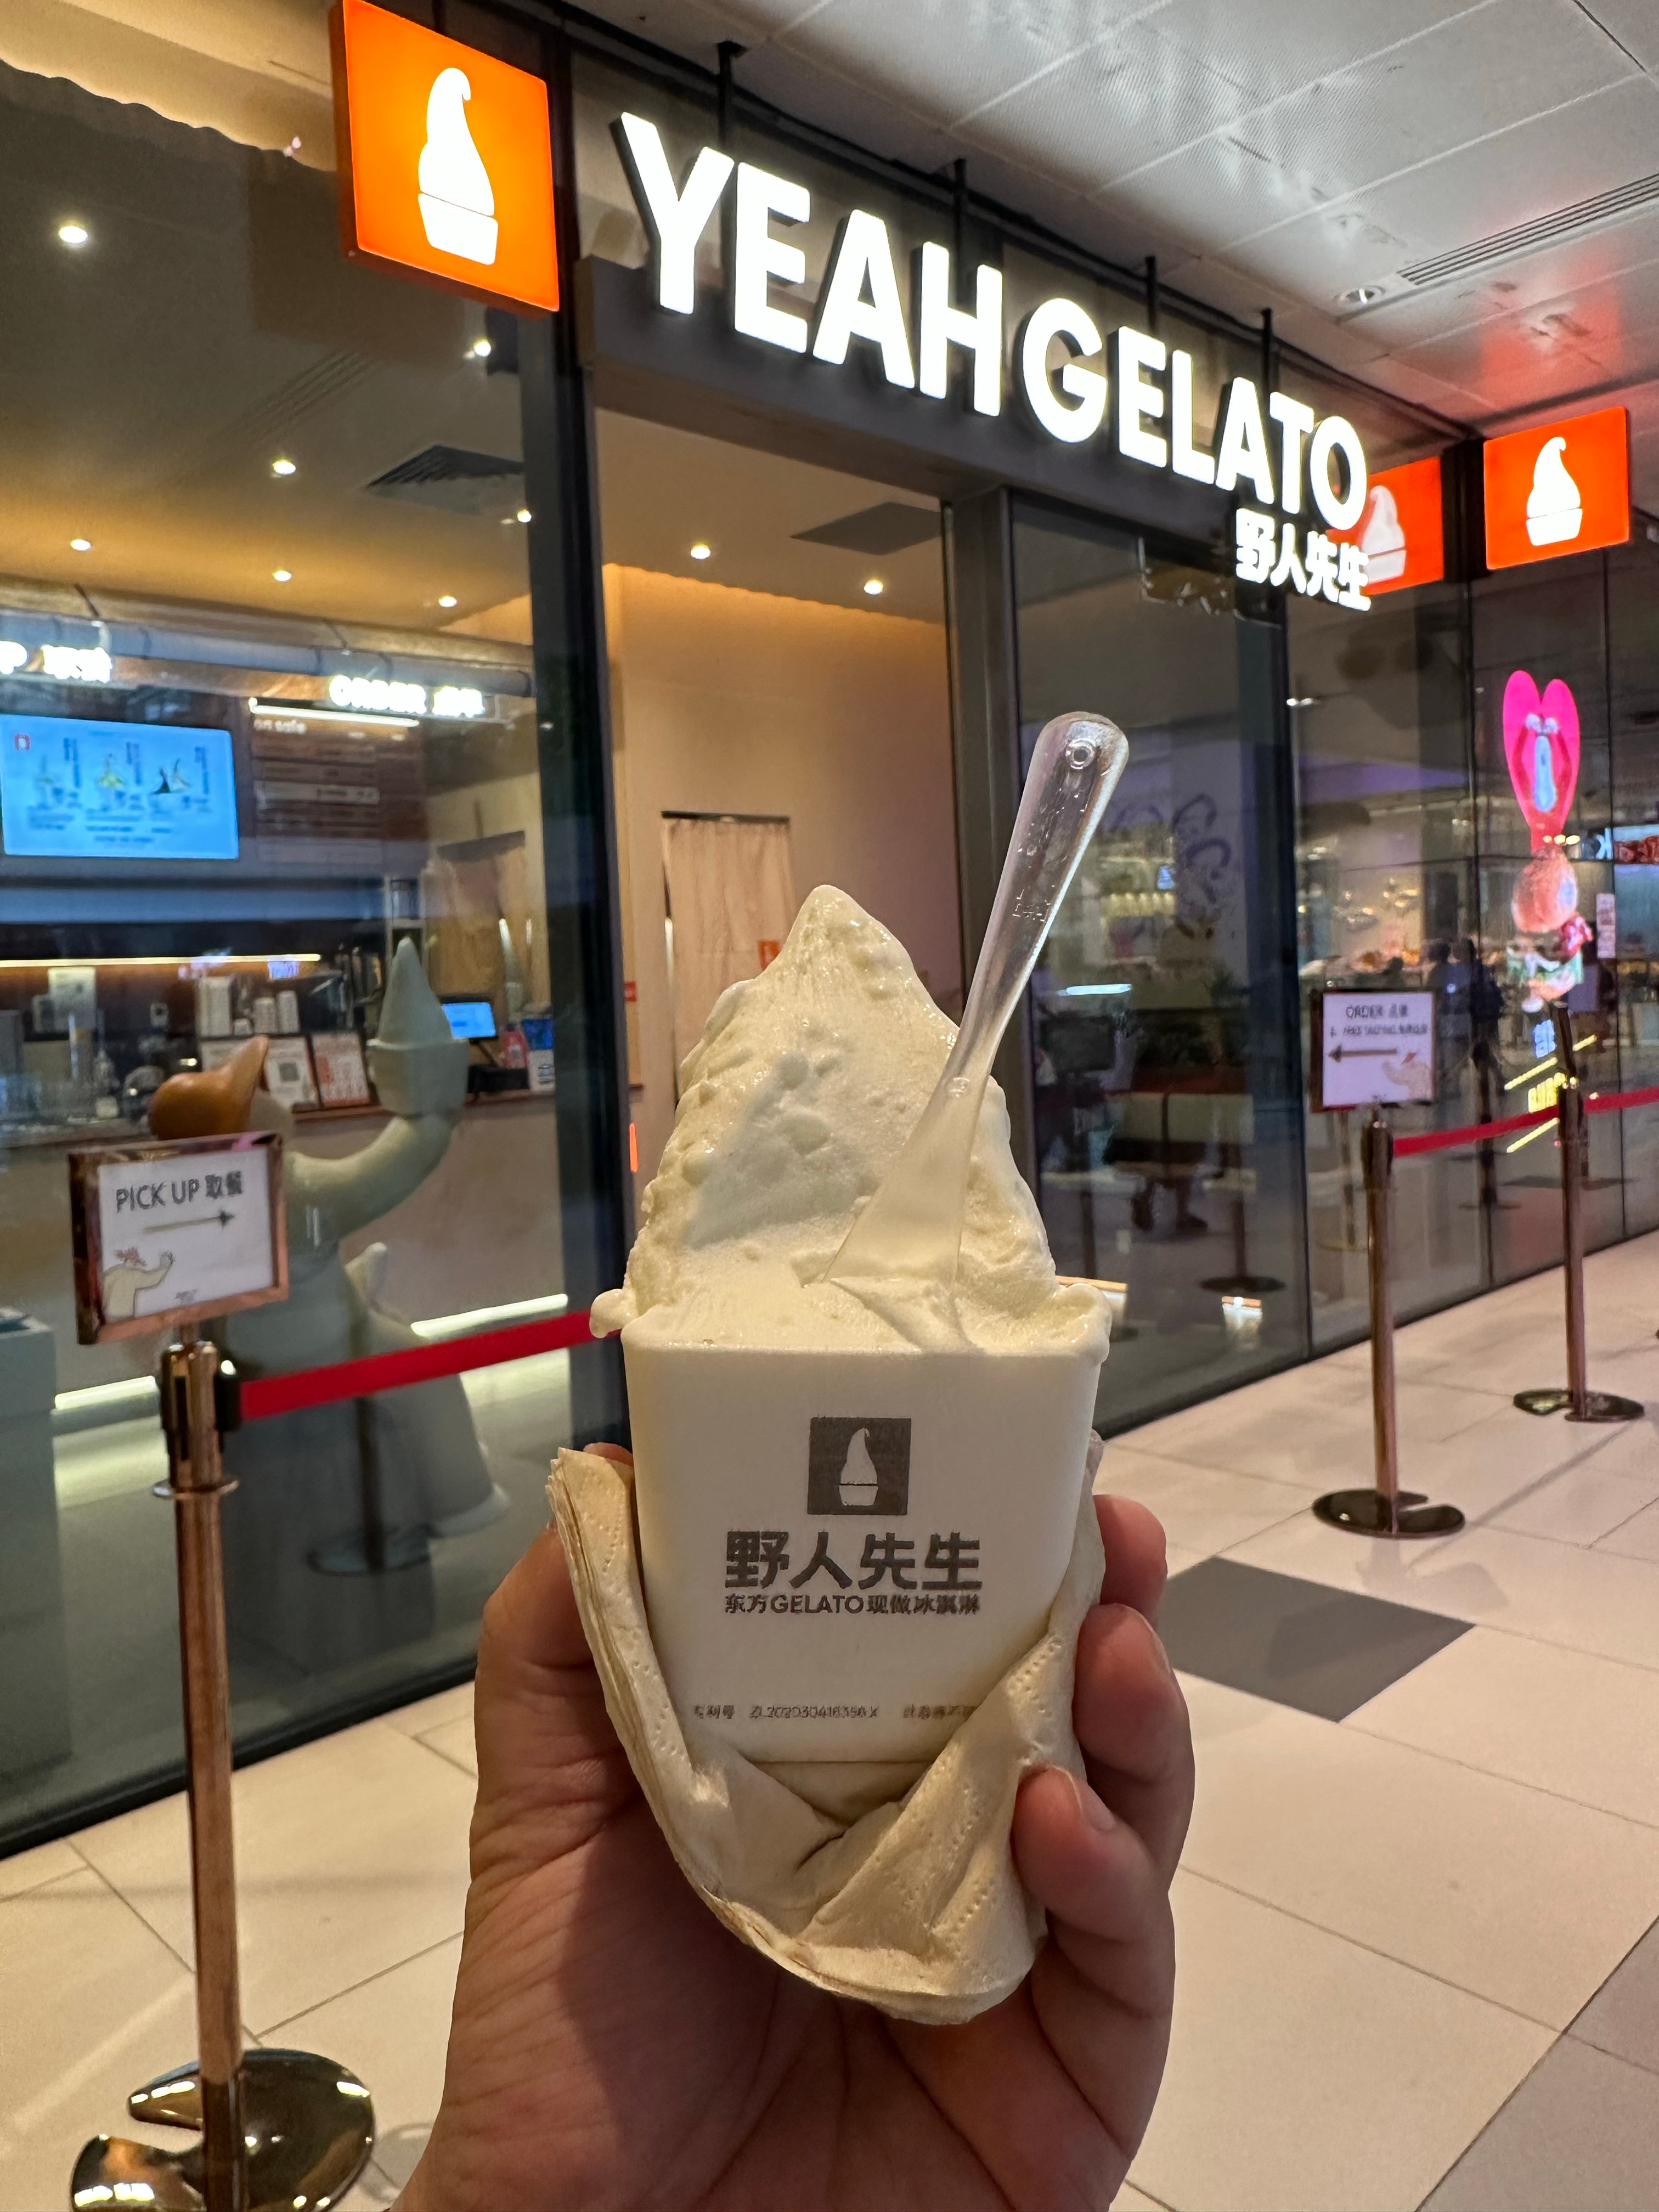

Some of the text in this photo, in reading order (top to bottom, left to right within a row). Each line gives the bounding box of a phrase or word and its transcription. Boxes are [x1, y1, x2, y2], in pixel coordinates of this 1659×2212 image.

[616, 111, 1369, 531] YEAH GELATO
[1235, 508, 1372, 611] 野人先生
[116, 1183, 165, 1212] PICK
[172, 1179, 199, 1204] UP
[725, 1530, 983, 1590] 野人先生
